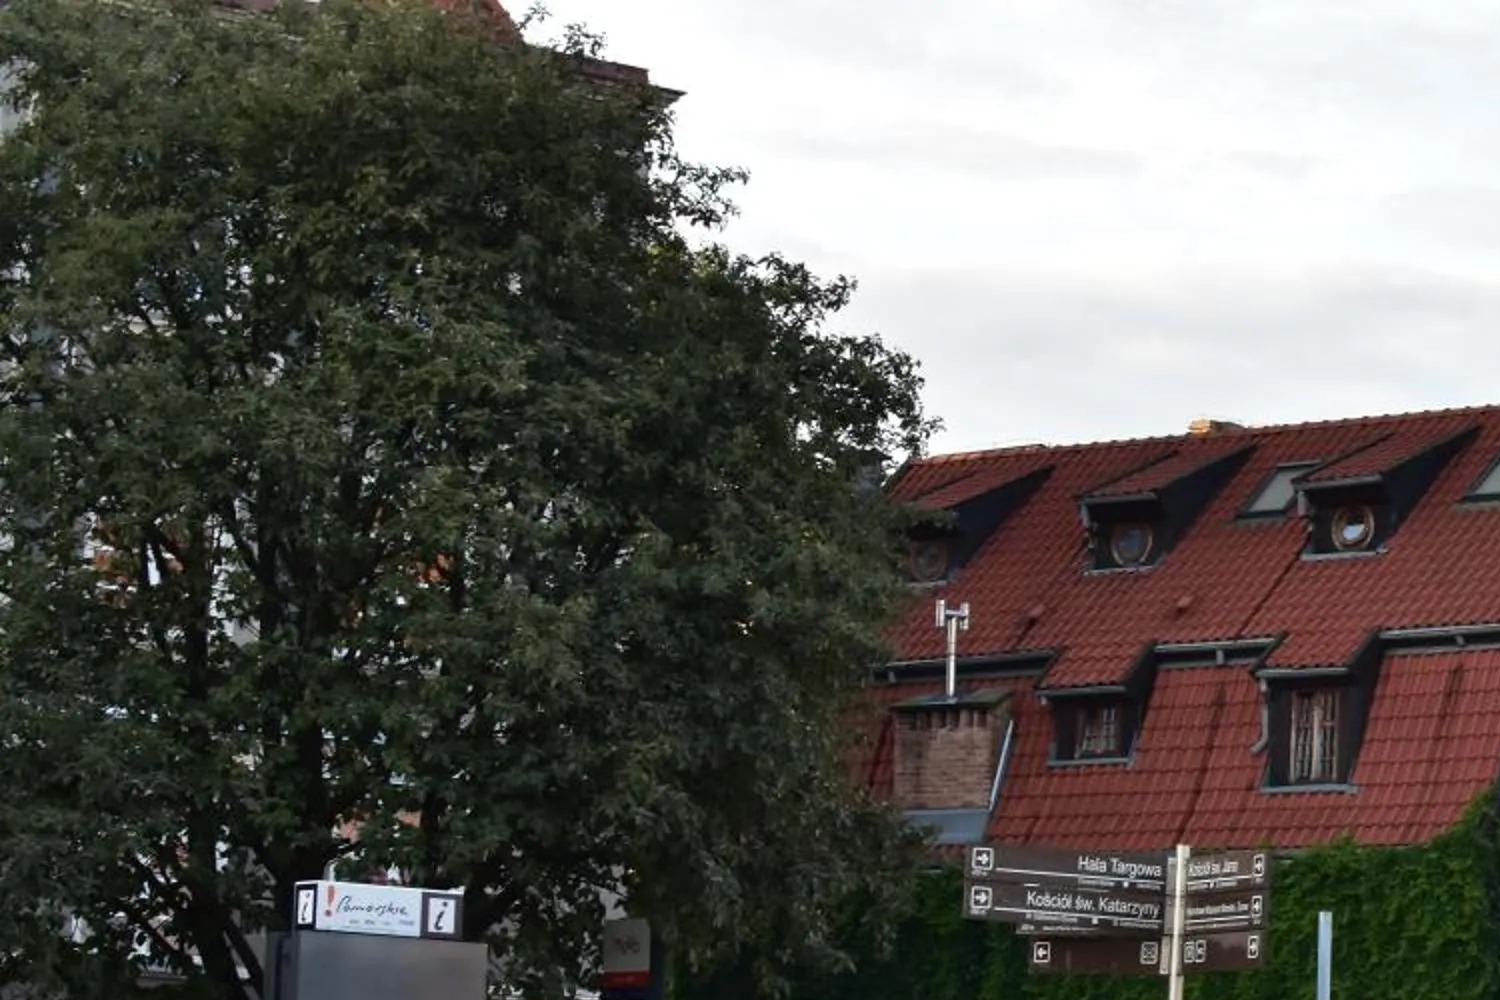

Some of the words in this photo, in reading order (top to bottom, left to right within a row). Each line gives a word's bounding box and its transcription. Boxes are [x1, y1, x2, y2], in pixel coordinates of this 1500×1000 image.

[1078, 855, 1108, 874] Hala
[1110, 857, 1162, 878] Targowa
[337, 895, 409, 917] Pomorskie
[1027, 890, 1073, 910] Kościół
[1075, 895, 1095, 911] św.
[1098, 898, 1160, 919] Katarzyny
